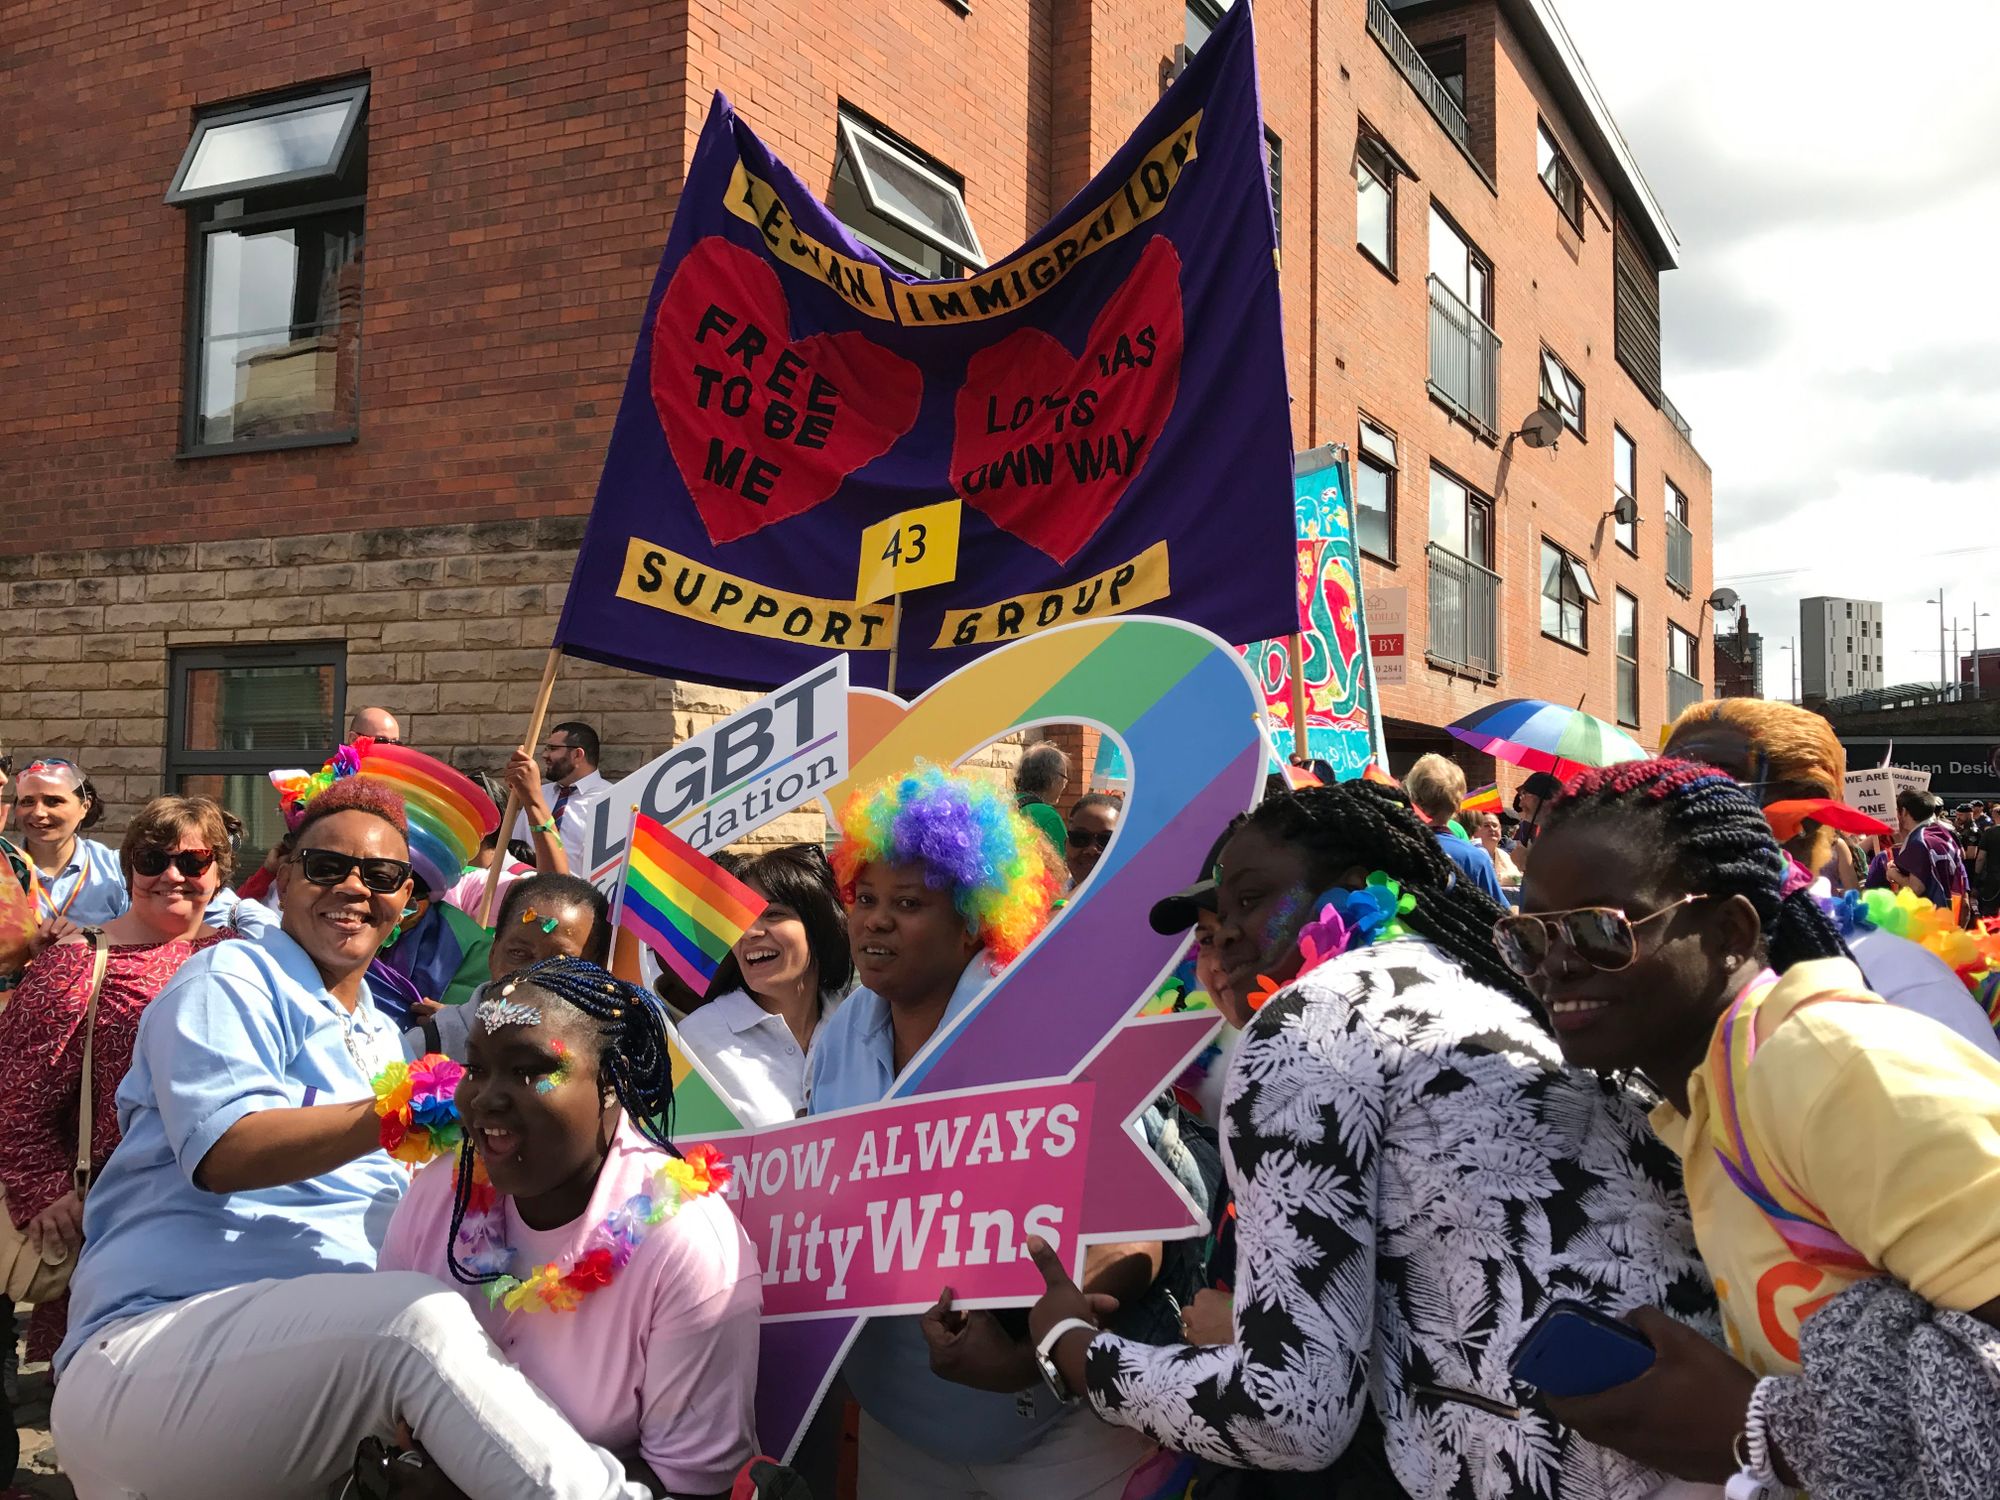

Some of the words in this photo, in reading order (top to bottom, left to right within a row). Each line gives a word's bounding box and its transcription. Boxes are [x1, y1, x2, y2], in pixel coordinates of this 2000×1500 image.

[743, 177, 876, 307] LESIAN
[694, 303, 840, 416] FREE
[692, 364, 753, 418] TO
[764, 399, 834, 450] BE
[703, 437, 782, 506] ME
[962, 443, 1054, 495] OWN
[1065, 428, 1147, 484] WAY
[881, 524, 926, 567] 43
[637, 551, 885, 646] SUPPORT
[952, 564, 1135, 646] GROUP
[1383, 664, 1402, 673] 2841
[590, 666, 838, 872] LGBT
[687, 754, 838, 851] dation
[1845, 775, 1862, 784] WE
[1866, 772, 1889, 782] ARE
[1859, 789, 1880, 798] ALL
[1949, 761, 1996, 777] Desig
[1858, 803, 1886, 814] ONE
[727, 1138, 840, 1200] NOW,
[849, 1103, 1080, 1182] ALWAYS
[761, 1190, 1065, 1301] lityWins
